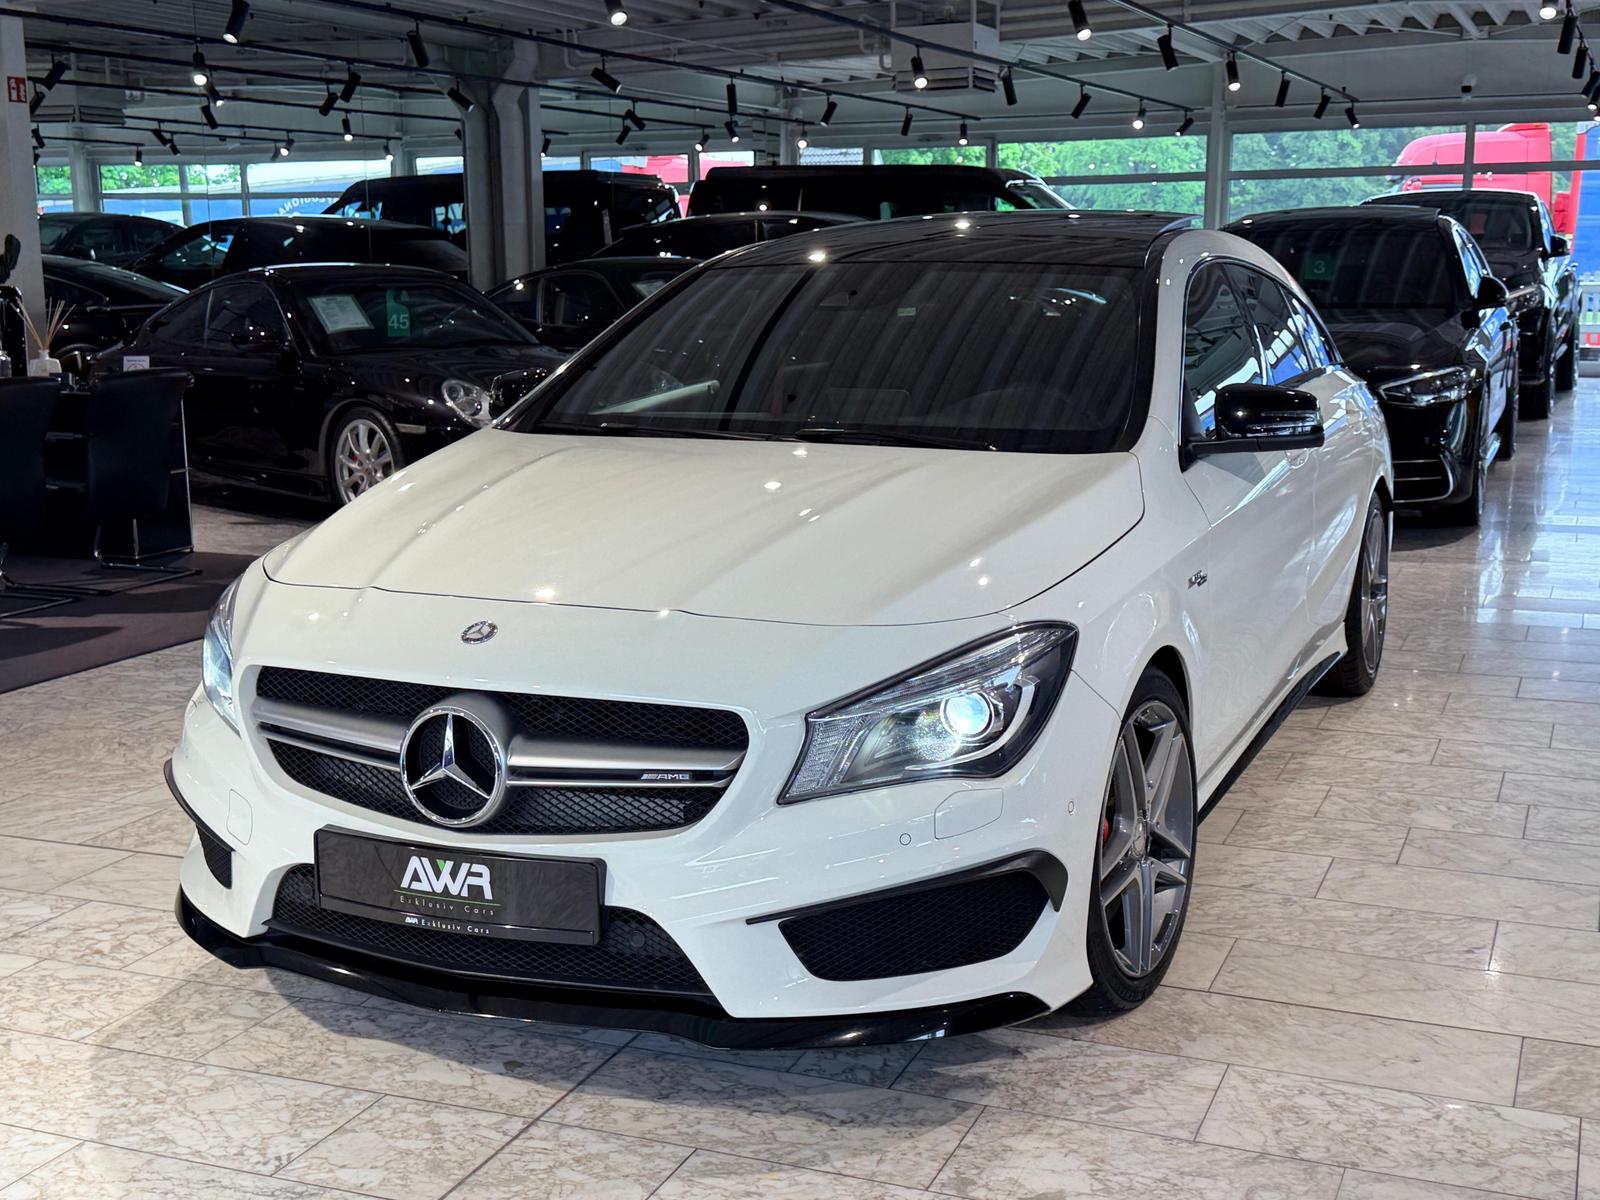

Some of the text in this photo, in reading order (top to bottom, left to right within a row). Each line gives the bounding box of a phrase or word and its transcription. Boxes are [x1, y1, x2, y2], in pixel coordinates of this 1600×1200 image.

[1313, 260, 1326, 273] 3
[388, 314, 410, 329] 45
[400, 855, 493, 900] AWR
[400, 895, 494, 915] Exklusiv Cars
[421, 919, 461, 930] Exklusiv
[467, 925, 490, 934] Cars
